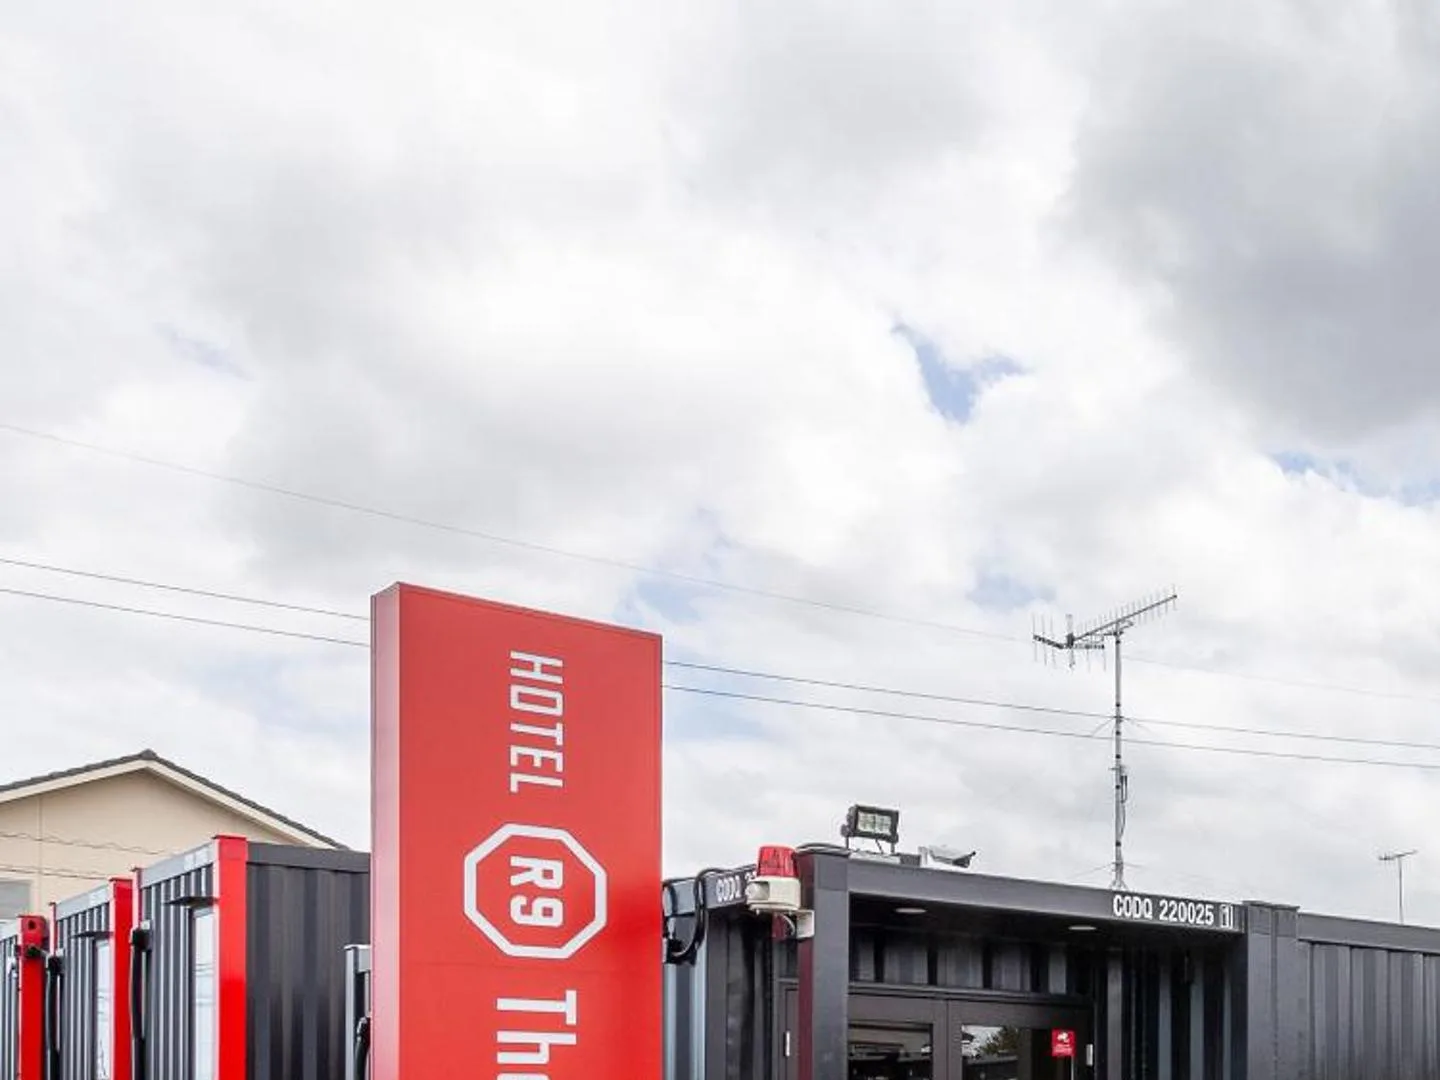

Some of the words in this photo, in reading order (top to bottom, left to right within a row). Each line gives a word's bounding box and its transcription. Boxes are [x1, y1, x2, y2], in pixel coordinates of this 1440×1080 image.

[510, 652, 564, 793] HOTEL
[510, 855, 564, 928] R9
[1113, 894, 1152, 919] CODQ
[1159, 899, 1214, 926] 220025
